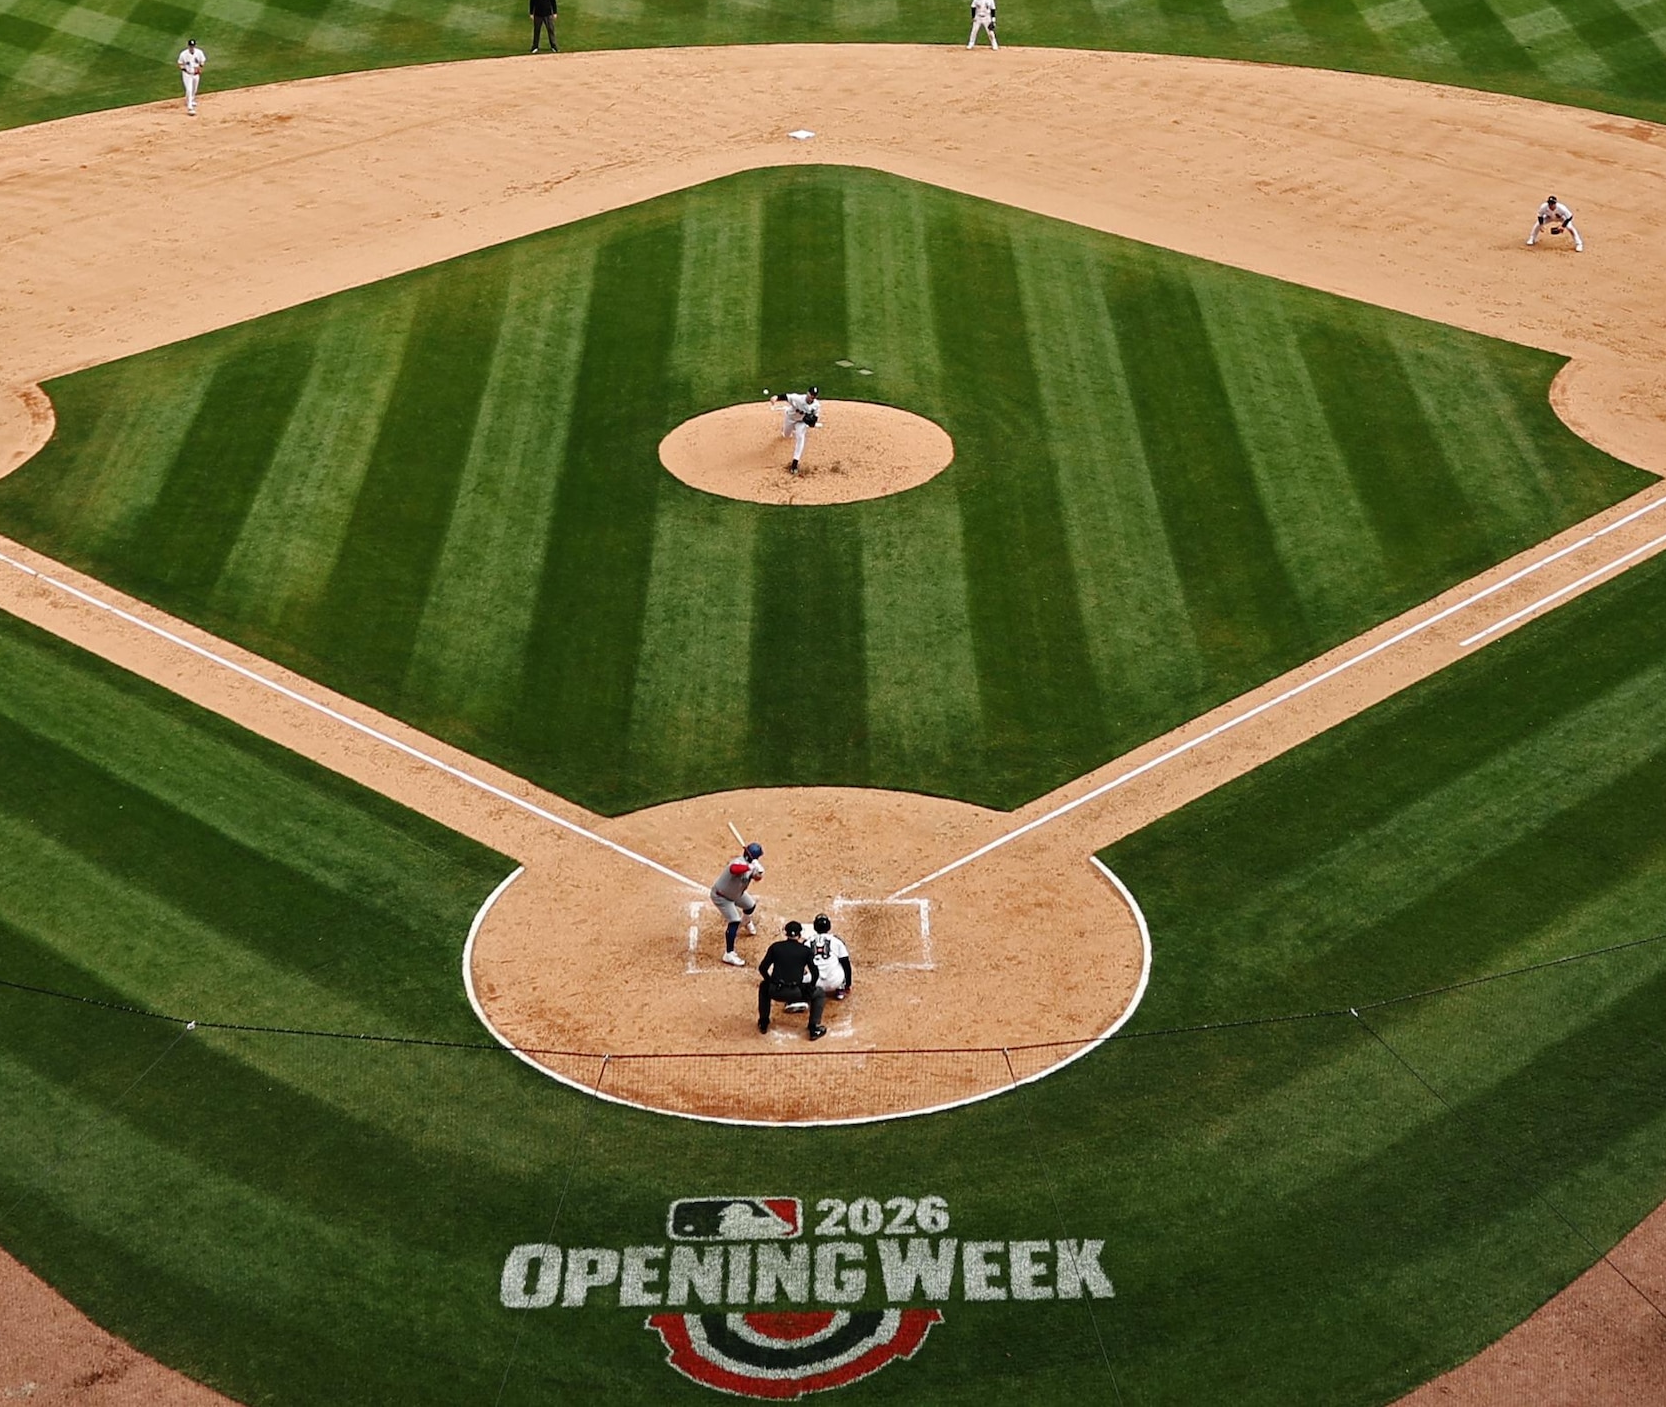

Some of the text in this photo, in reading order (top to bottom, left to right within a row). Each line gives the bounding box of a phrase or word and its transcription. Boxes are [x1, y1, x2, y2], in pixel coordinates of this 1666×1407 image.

[814, 1196, 950, 1236] 2026
[499, 1238, 1116, 1309] OPENING WEEK
